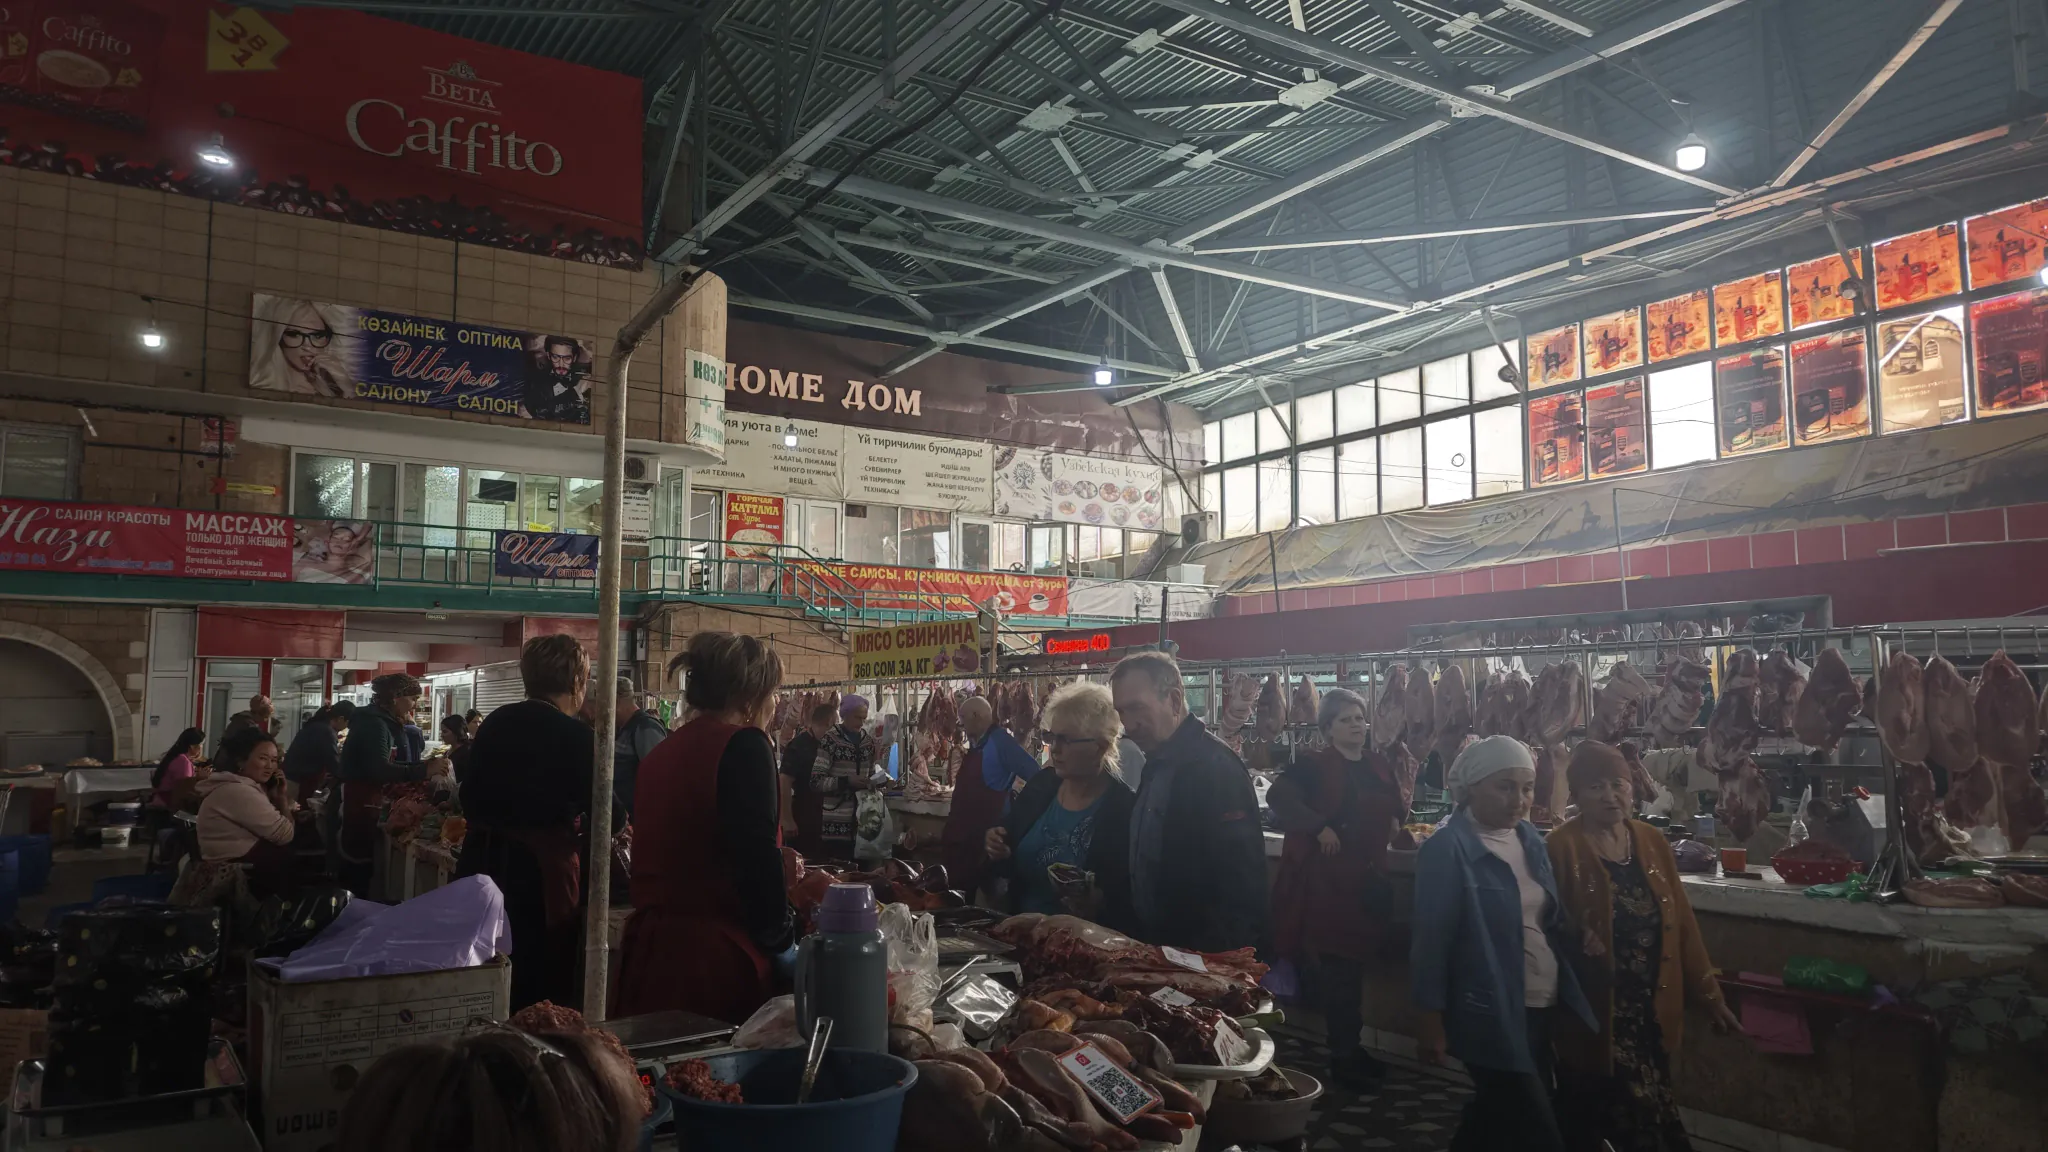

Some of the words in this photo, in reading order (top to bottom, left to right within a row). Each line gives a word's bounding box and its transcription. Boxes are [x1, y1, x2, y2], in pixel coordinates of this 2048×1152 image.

[42, 15, 132, 57] Caffito
[427, 72, 497, 110] BETA
[345, 97, 564, 177] Caffito
[358, 314, 446, 342] КӨЗАЙНЕК
[457, 328, 523, 352] ОПТИКА
[376, 338, 500, 396] Шарм
[354, 382, 432, 406] САЛОНУ
[458, 393, 519, 416] САЛОН
[841, 379, 922, 417] ДОМ
[742, 419, 772, 434] уюта
[774, 424, 782, 434] в
[725, 437, 750, 447] ДАРКИ
[873, 437, 926, 452] тиричилик
[928, 442, 983, 460] буюмдары!
[804, 457, 837, 468] ПИЖАМЫ
[864, 465, 902, 475] СУВЕНИРЛЕР
[868, 455, 898, 464] БЕЛЕКТЕР
[712, 468, 746, 479] ТЕХНИКА
[779, 465, 806, 475] МНОГО
[806, 468, 837, 478] НУЖНЫХ
[731, 502, 780, 516] КАТТАМА
[736, 494, 773, 505] ГОРЯЧАЯ
[55, 507, 103, 523] САЛОН
[107, 510, 171, 527] КРАСОТЫ
[185, 512, 287, 537] МАССАЖ
[728, 513, 740, 521] от
[185, 545, 239, 556] Классический
[186, 532, 222, 545] ТОЛЬКО
[224, 534, 244, 547] ДЛЯ
[246, 535, 288, 549] ЖЕНЩИН
[501, 532, 590, 577] Шарм
[556, 568, 596, 579] ОПТИКА
[850, 567, 901, 583] САМСЫ,
[905, 570, 964, 586] КУРНИКИ,
[966, 574, 1020, 589] КАТТАМА
[1022, 578, 1036, 589] от
[1037, 576, 1067, 591] Зуры
[856, 630, 892, 653] МЯСО
[895, 621, 977, 650] СВИНИНА
[1047, 636, 1089, 655] Свинина
[1090, 633, 1110, 651] 400
[854, 662, 871, 679] 360
[873, 660, 896, 678] СОМ
[899, 658, 913, 676] ЗА
[916, 657, 931, 675] КГ
